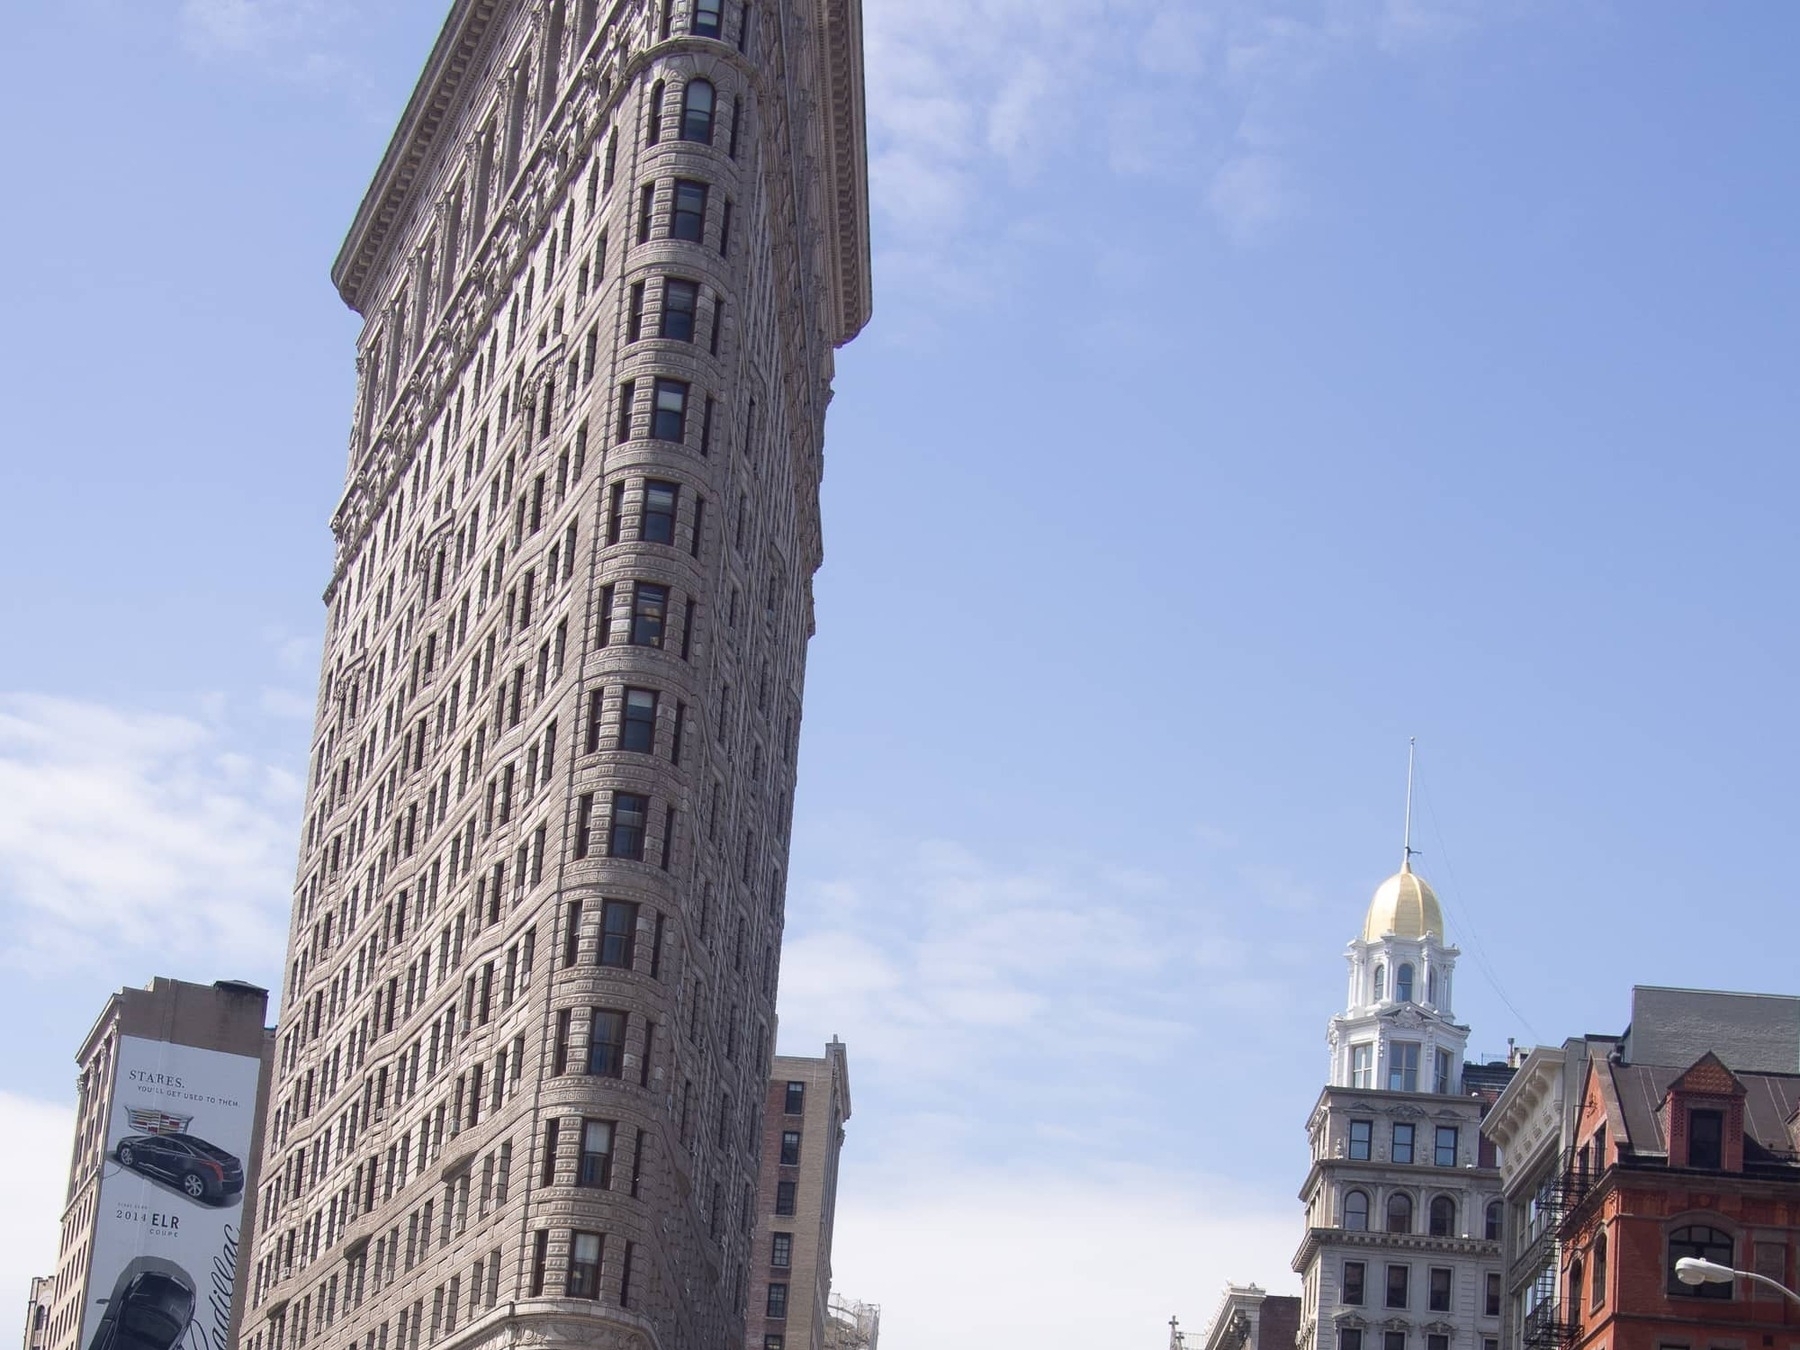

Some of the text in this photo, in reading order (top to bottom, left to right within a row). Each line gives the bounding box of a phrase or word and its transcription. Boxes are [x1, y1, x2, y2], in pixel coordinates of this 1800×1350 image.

[129, 1069, 185, 1088] STARES.
[138, 1085, 164, 1095] YOU'LL
[166, 1089, 181, 1097] GET
[184, 1093, 204, 1102] USED
[206, 1096, 216, 1104] TO
[116, 1209, 180, 1230] 2014 ELR
